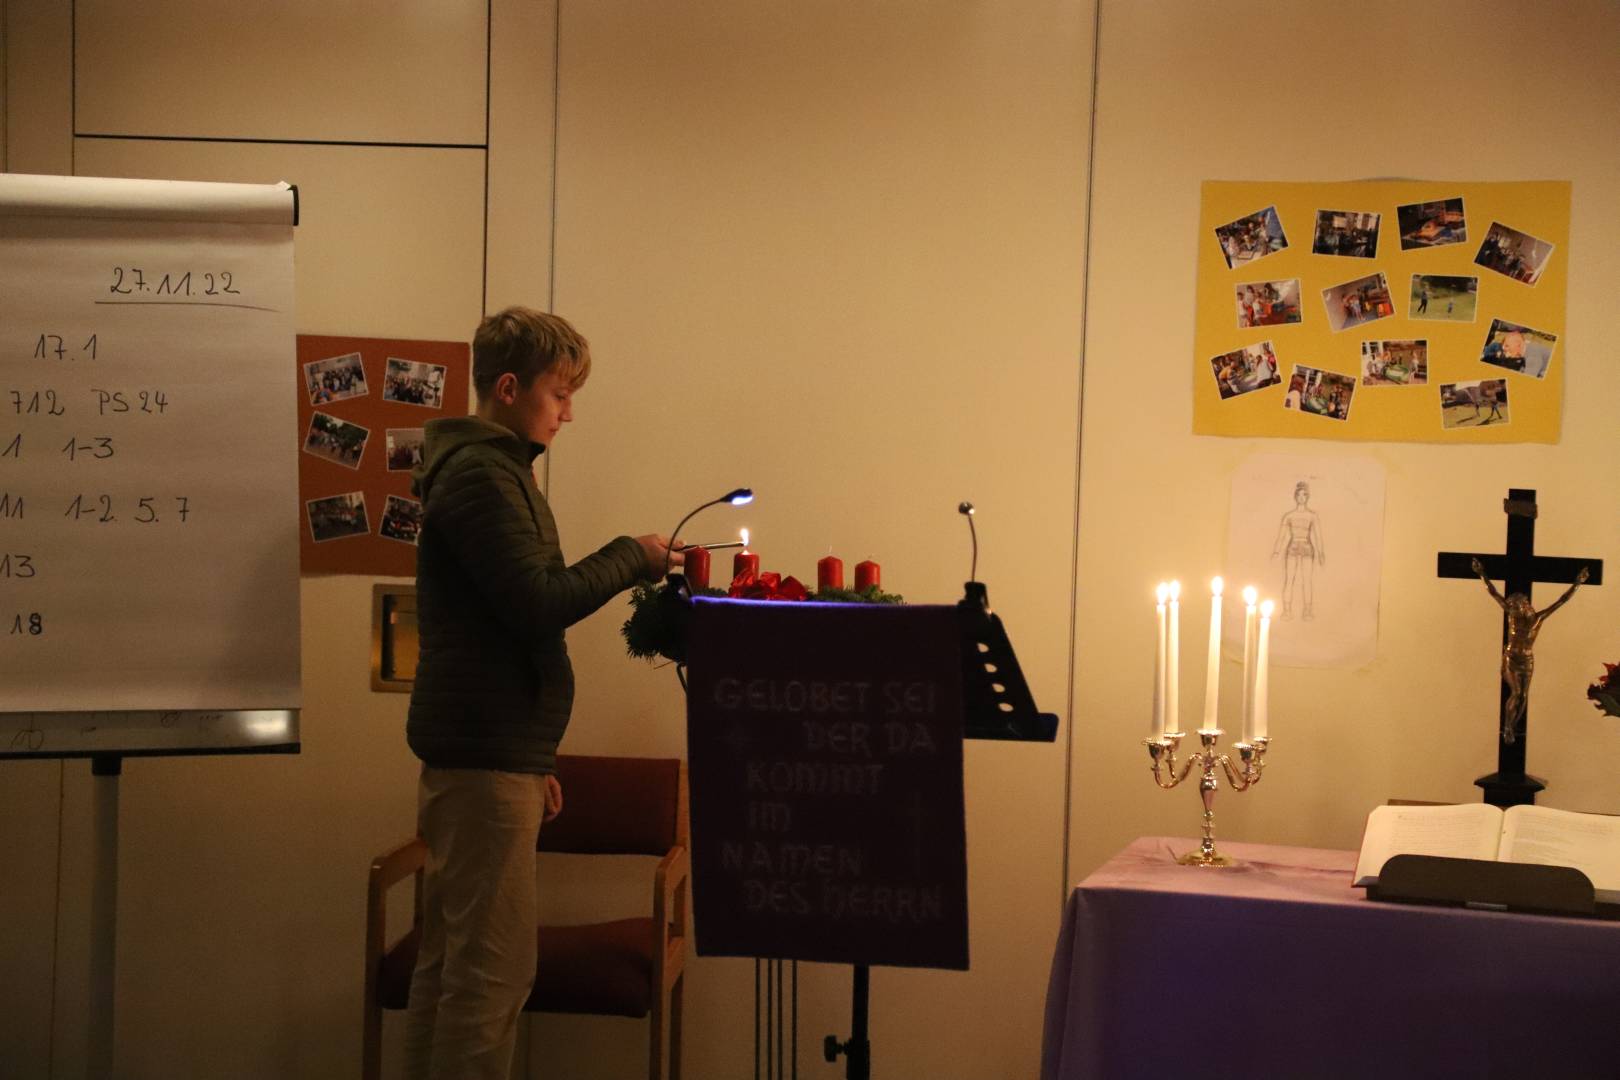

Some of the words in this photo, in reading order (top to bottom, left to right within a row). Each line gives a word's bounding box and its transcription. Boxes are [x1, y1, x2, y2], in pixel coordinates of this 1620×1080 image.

[110, 267, 241, 296] 27.11.22
[10, 390, 65, 416] 712
[90, 388, 129, 415] PS
[139, 391, 169, 413] 24
[62, 437, 114, 461] 1-3
[10, 613, 43, 635] 18
[712, 677, 871, 712] GELOBET
[882, 680, 936, 713] SEI
[885, 722, 936, 752] DA
[745, 761, 885, 794] KOMMT
[721, 842, 863, 876] NAMEN
[744, 879, 809, 914] DES
